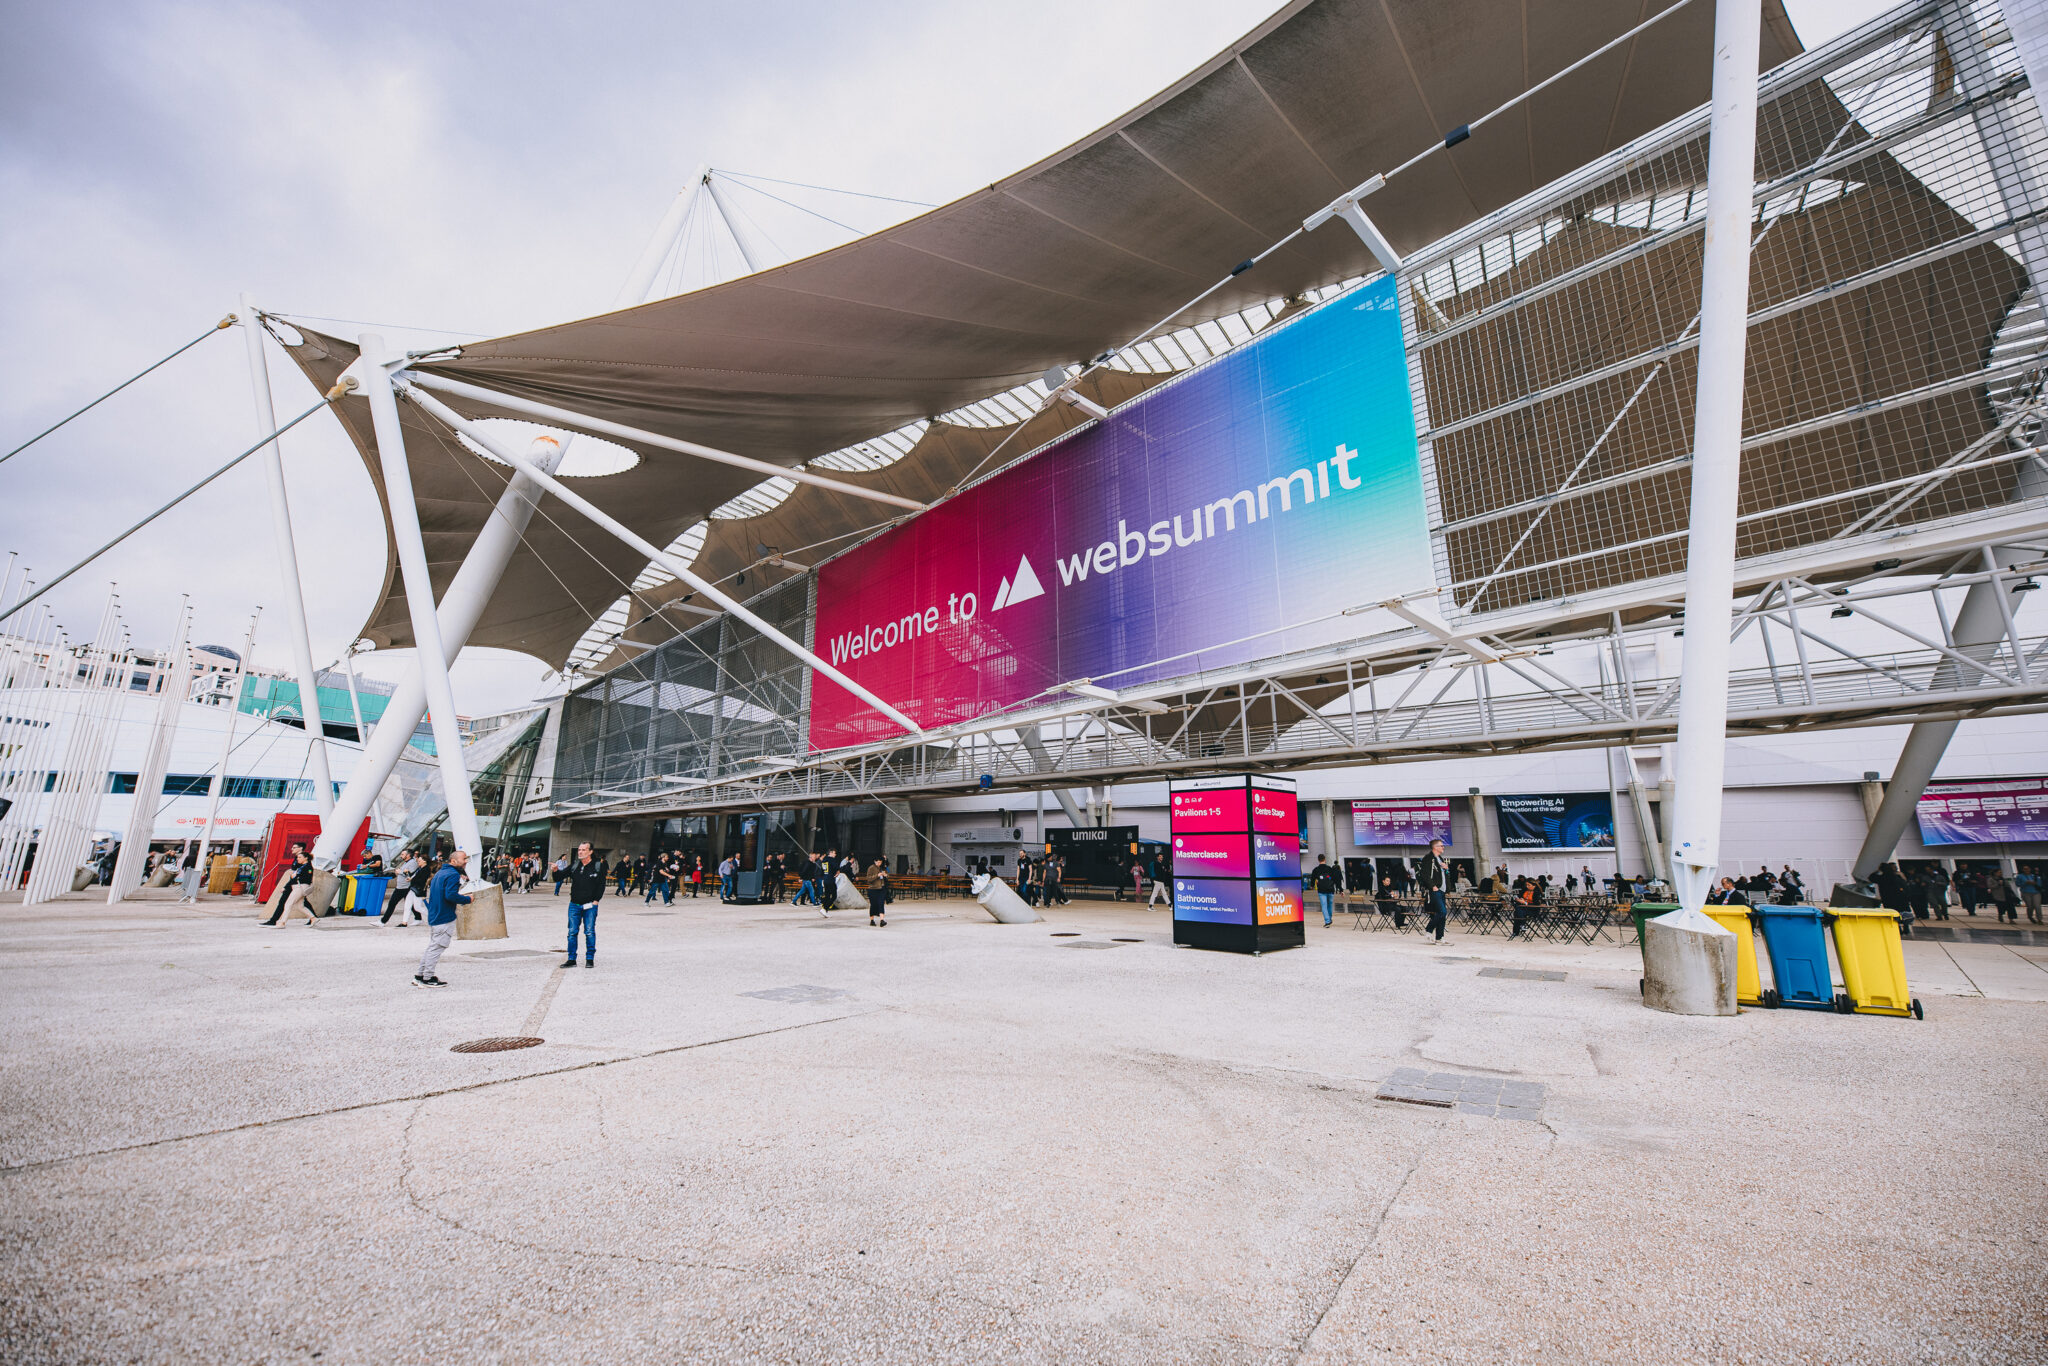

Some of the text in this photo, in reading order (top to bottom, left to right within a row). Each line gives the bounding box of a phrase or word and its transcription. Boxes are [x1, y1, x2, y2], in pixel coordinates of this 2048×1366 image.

[831, 443, 1361, 666] Welcome to websummit
[1501, 798, 1554, 807] Empowering
[1174, 807, 1221, 817] Pavilions 1-5
[1255, 807, 1285, 818] Centre Stage
[1176, 850, 1228, 859] Masterclasses
[1257, 852, 1286, 861] Pavilions 1-5
[1177, 894, 1217, 904] Bathrooms
[1265, 893, 1285, 904] FOOD
[1266, 904, 1292, 916] SUMMIT
